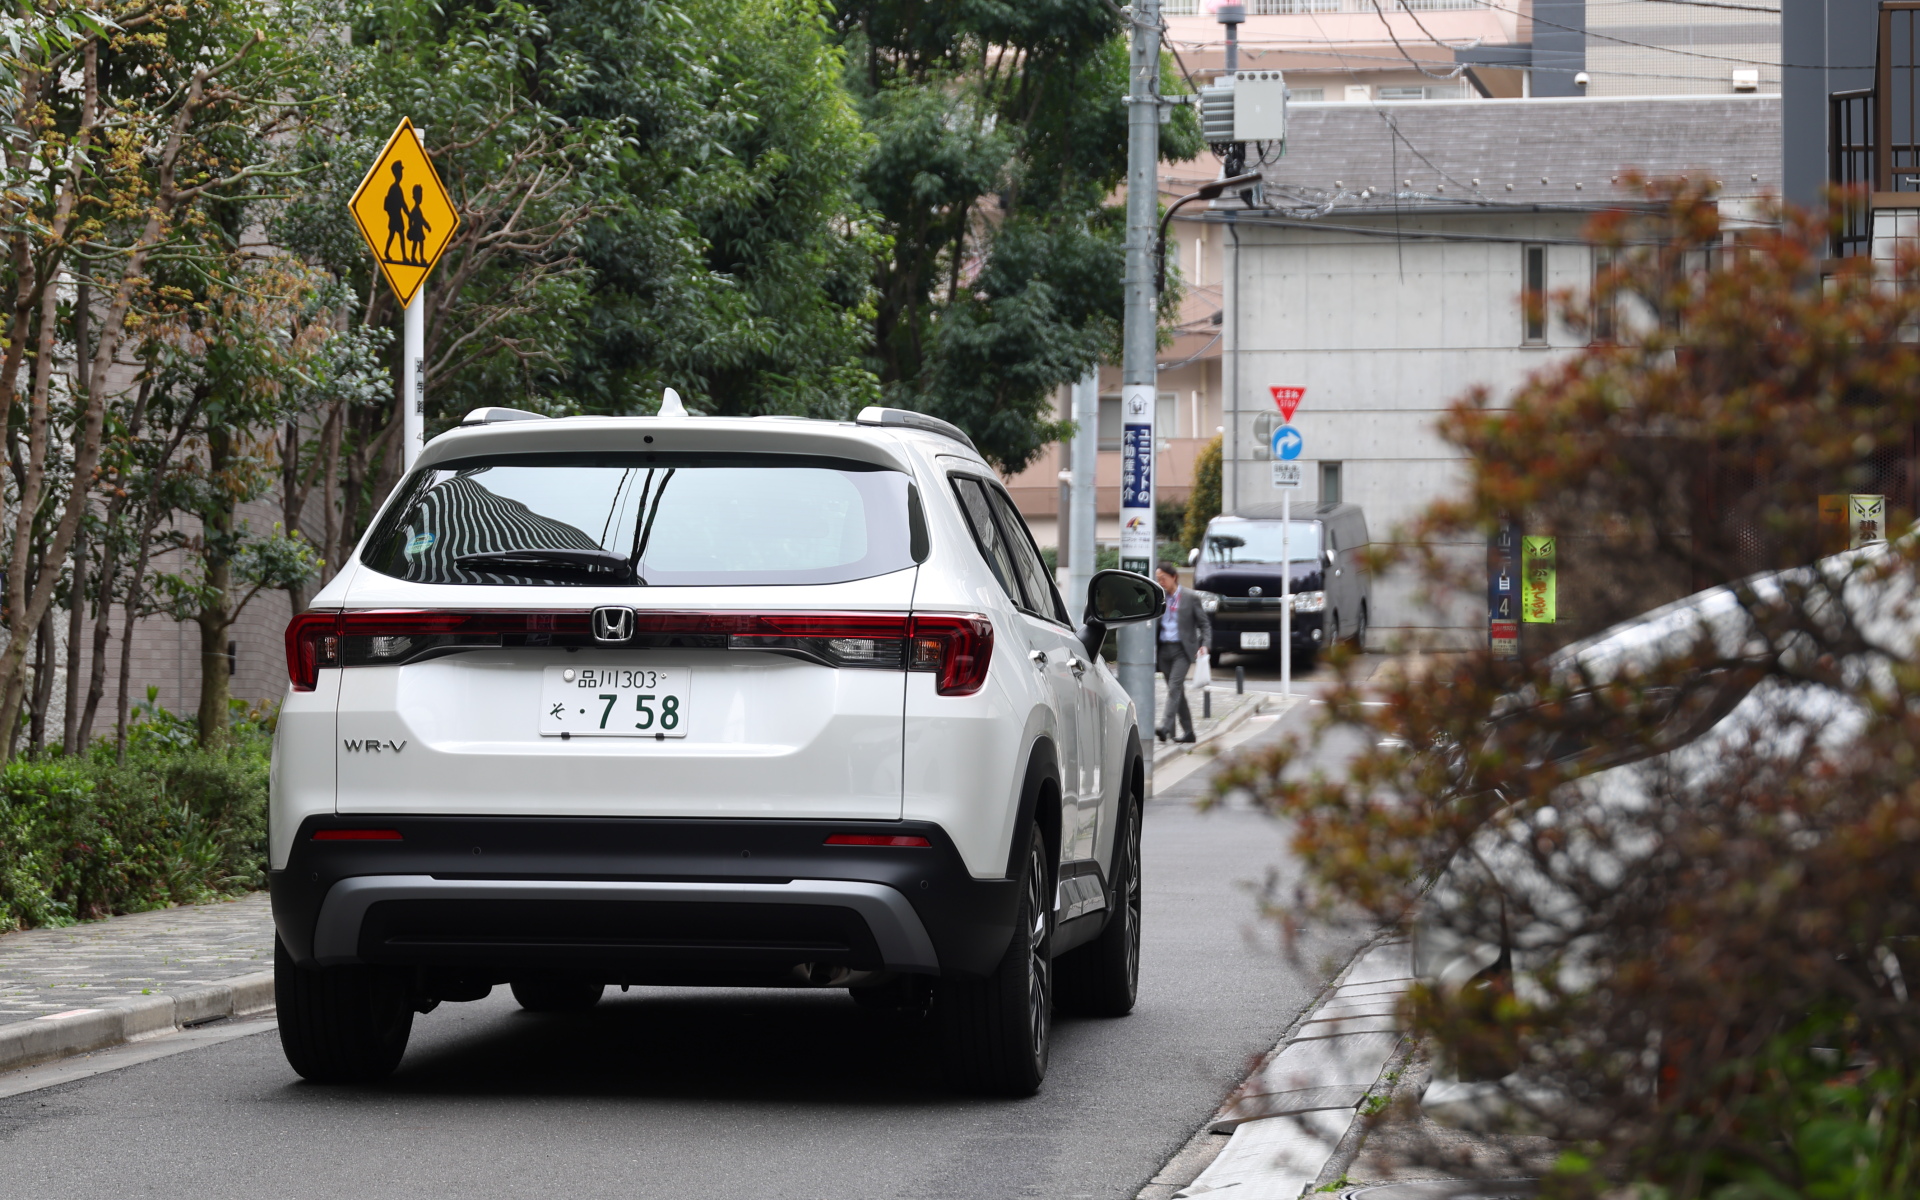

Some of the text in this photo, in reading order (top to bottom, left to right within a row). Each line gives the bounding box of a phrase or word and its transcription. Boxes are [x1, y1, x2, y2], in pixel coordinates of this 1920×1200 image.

[1276, 389, 1300, 399] 止まれ
[1280, 400, 1297, 408] STOP
[1123, 430, 1136, 502] 不動産仲介
[1138, 429, 1150, 503] ユニマットの
[1499, 598, 1510, 616] 4
[550, 702, 566, 720] そ
[343, 739, 408, 752] WR-V
